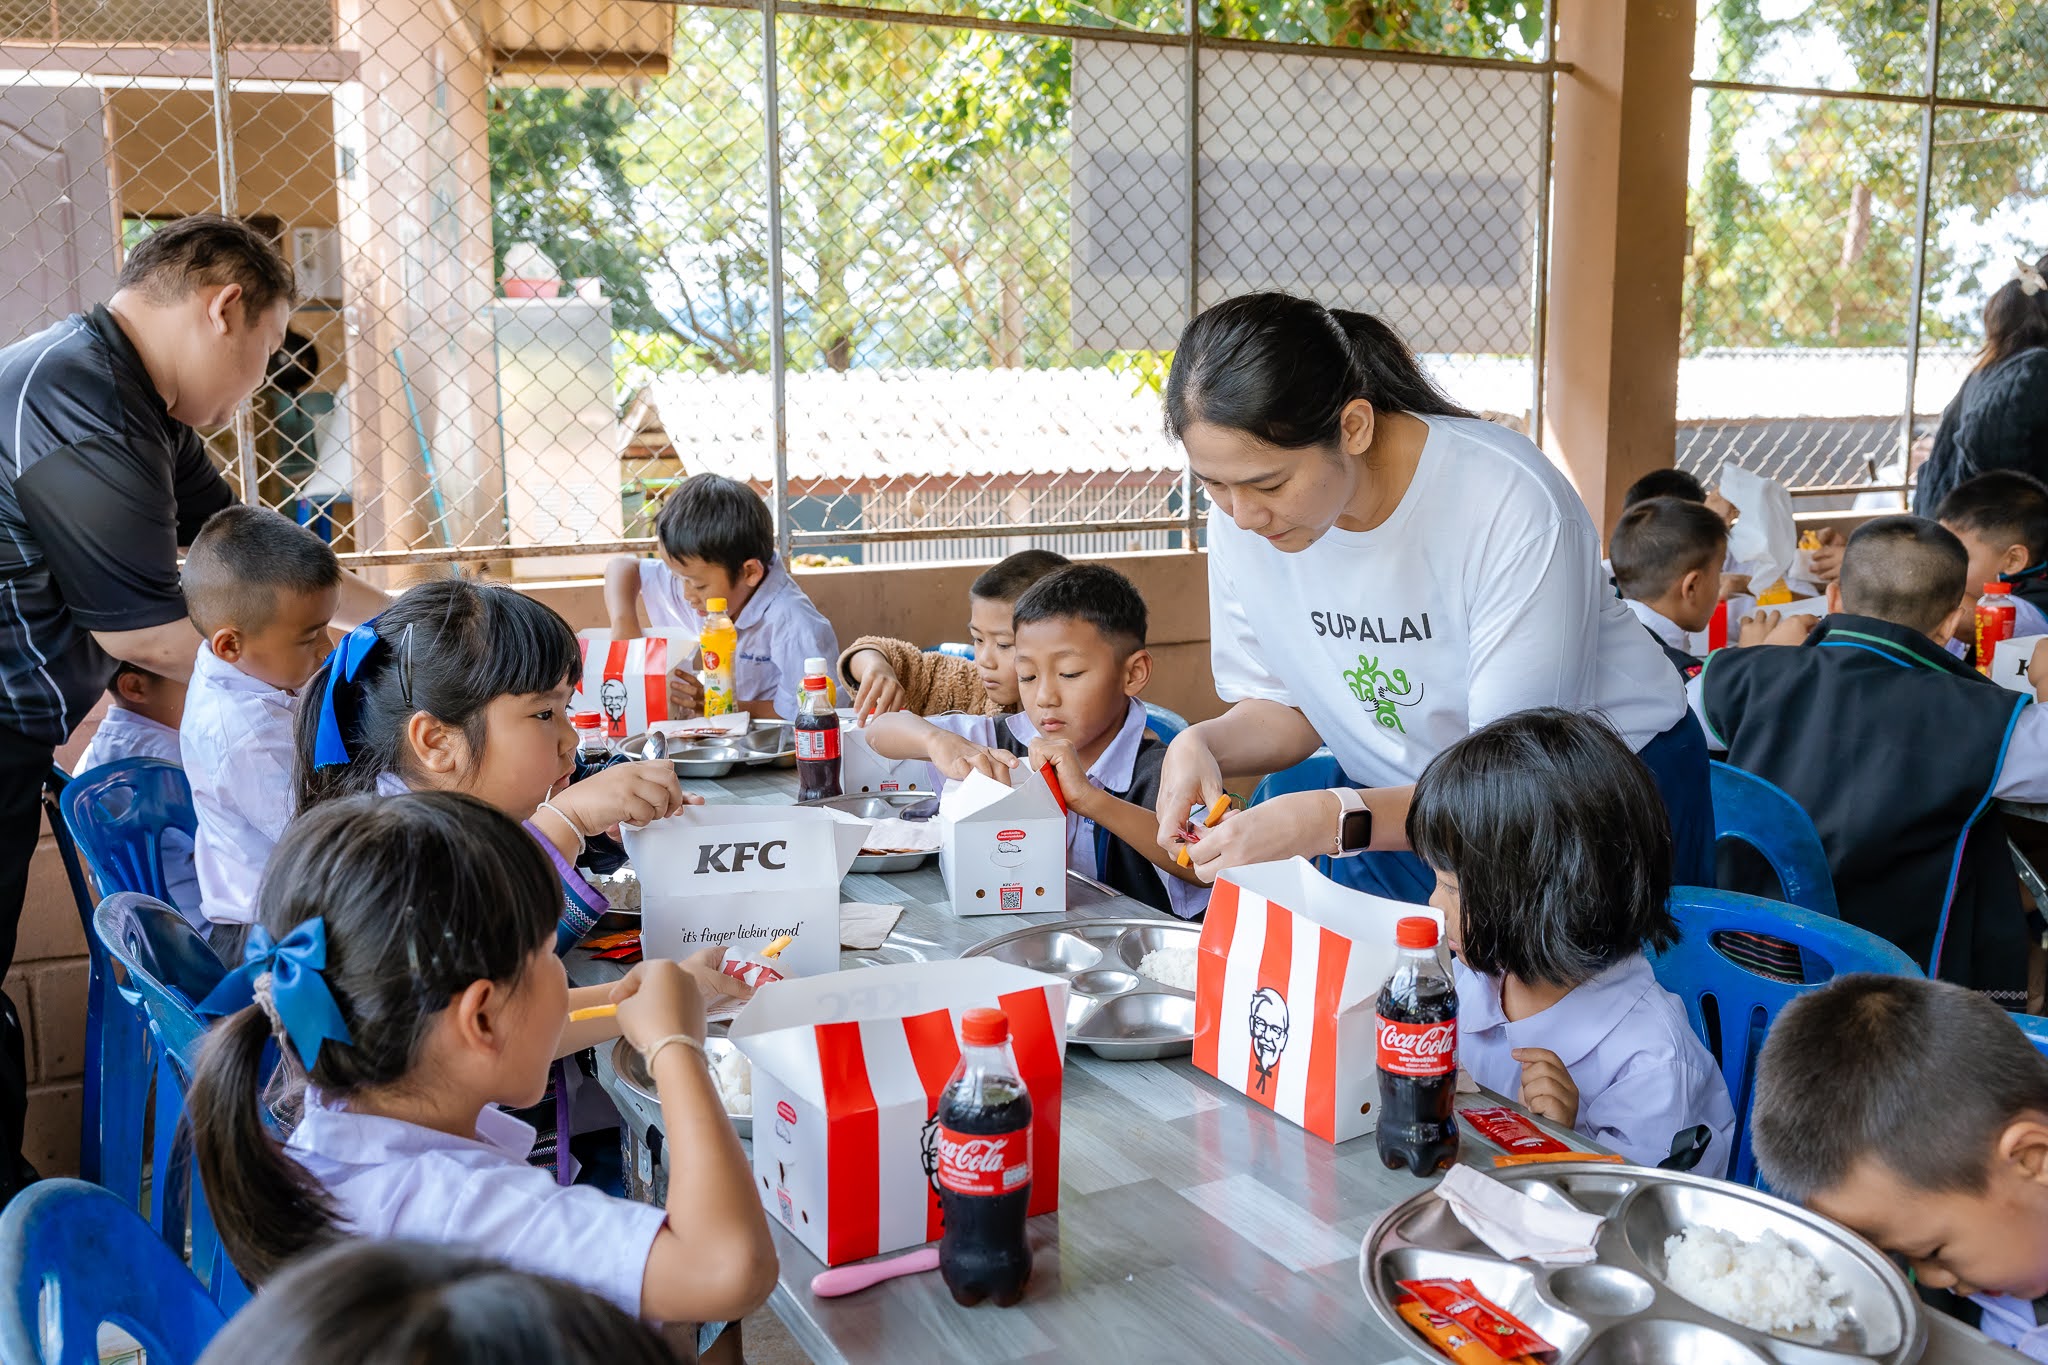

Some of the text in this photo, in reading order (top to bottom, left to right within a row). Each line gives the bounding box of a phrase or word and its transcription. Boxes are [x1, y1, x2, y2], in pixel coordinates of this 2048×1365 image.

[1310, 611, 1432, 643] SUPALAI
[693, 840, 787, 874] KFC
[700, 927, 736, 946] finger
[722, 959, 785, 988] KF
[1381, 1024, 1456, 1056] Coca-Cola
